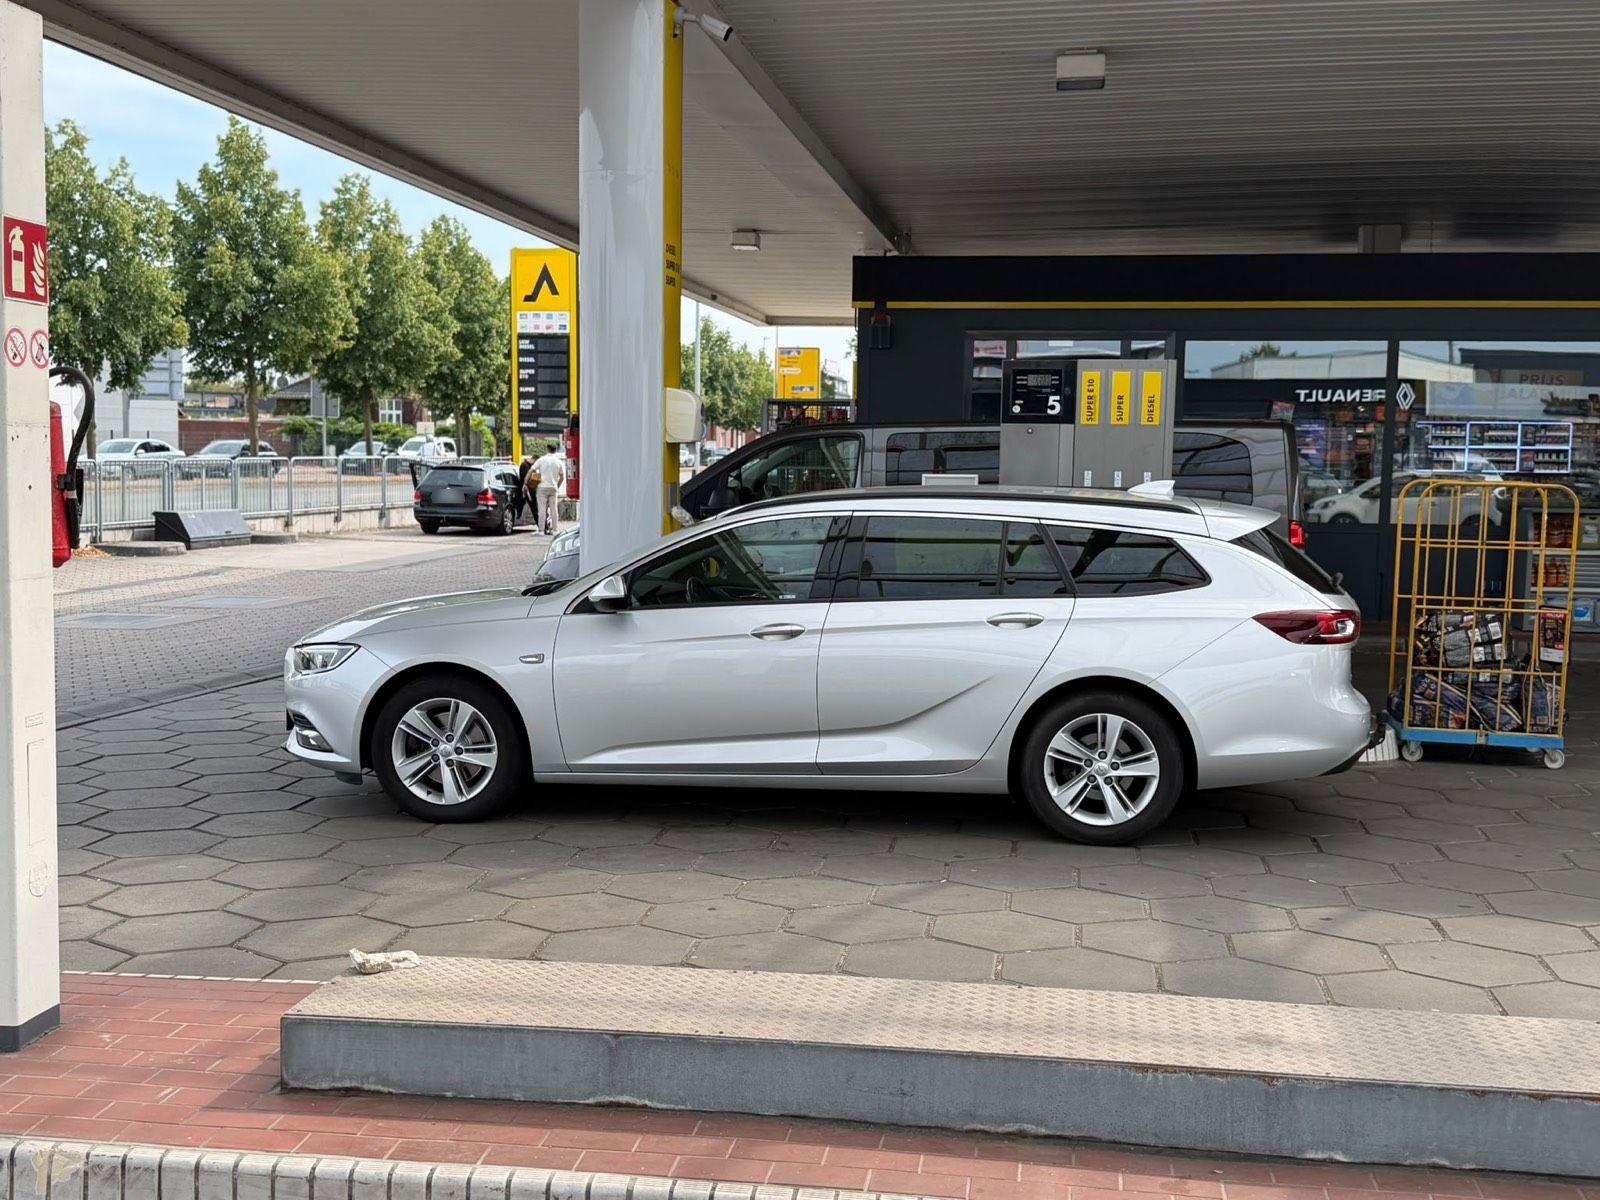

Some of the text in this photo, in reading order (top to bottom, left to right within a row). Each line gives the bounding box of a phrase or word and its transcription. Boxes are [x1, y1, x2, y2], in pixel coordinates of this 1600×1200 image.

[1046, 395, 1062, 415] 5
[1085, 378, 1095, 422] SUPER E10
[1116, 394, 1124, 422] SUPER
[1146, 394, 1155, 423] DIESEL
